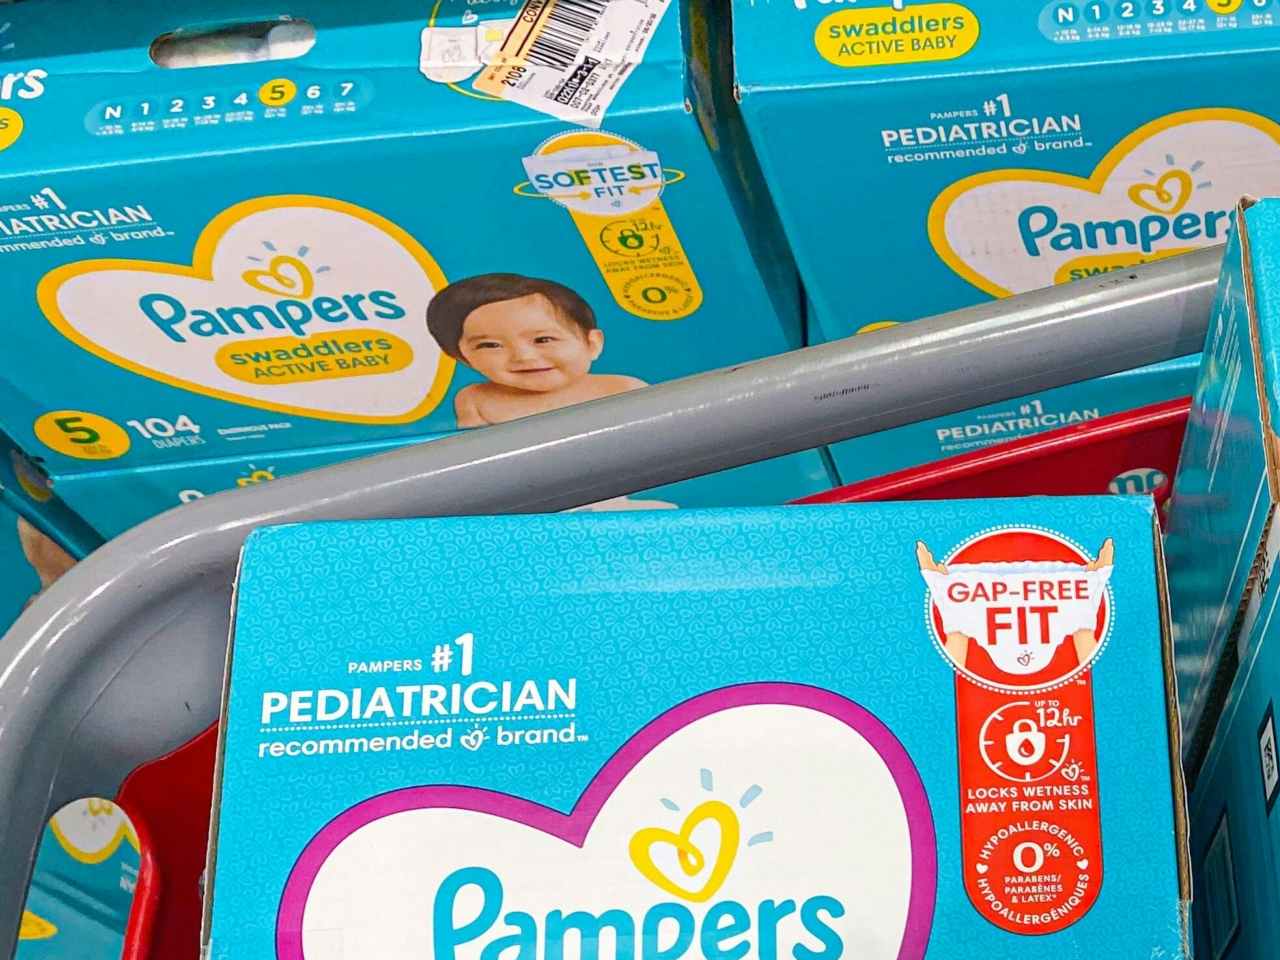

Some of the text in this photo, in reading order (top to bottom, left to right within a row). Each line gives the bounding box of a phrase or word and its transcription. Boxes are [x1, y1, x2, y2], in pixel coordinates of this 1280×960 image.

[1057, 1, 1165, 23] N 1 2 3
[828, 13, 965, 39] swaddlers
[837, 34, 957, 57] ACTIVE BABY
[501, 65, 527, 87] 2108
[104, 104, 122, 120] N
[140, 102, 150, 116] 1
[169, 99, 184, 113] 2
[201, 95, 216, 110] 3
[233, 92, 249, 106] 4
[270, 85, 286, 101] 5
[306, 85, 321, 99] 6
[340, 82, 354, 97] 7
[930, 93, 1012, 120] PAMPERS #1
[881, 114, 1082, 147] PEDIATRICIAN
[887, 144, 1007, 164] recommended
[535, 162, 659, 190] SOFTEST
[30, 187, 67, 210] #1
[594, 185, 625, 199] FIT
[139, 290, 406, 343] Pampers
[229, 336, 393, 365] swaddlers
[254, 353, 391, 379] ACTIVE BABY
[1019, 400, 1044, 416] #1
[54, 417, 100, 444] 5
[127, 414, 201, 437] 104
[936, 408, 1100, 441] PEDIATRICIAN
[153, 434, 206, 451] DIAPERS
[947, 579, 1090, 604] GAP-FREE
[986, 606, 1058, 646] FIT
[347, 632, 475, 676] PAMPERS #1
[260, 678, 577, 726] PEDIATRICIAN
[1036, 708, 1083, 728] 12hr
[258, 727, 453, 759] recommended
[967, 784, 1089, 800] LOCKS WETNESS
[965, 799, 1093, 814] AWAY FROM SKIN
[979, 820, 1085, 861] HYPOALLERGENIC
[1012, 841, 1061, 873] 0%
[977, 873, 1090, 926] HYPOALLERGÉNIQUES
